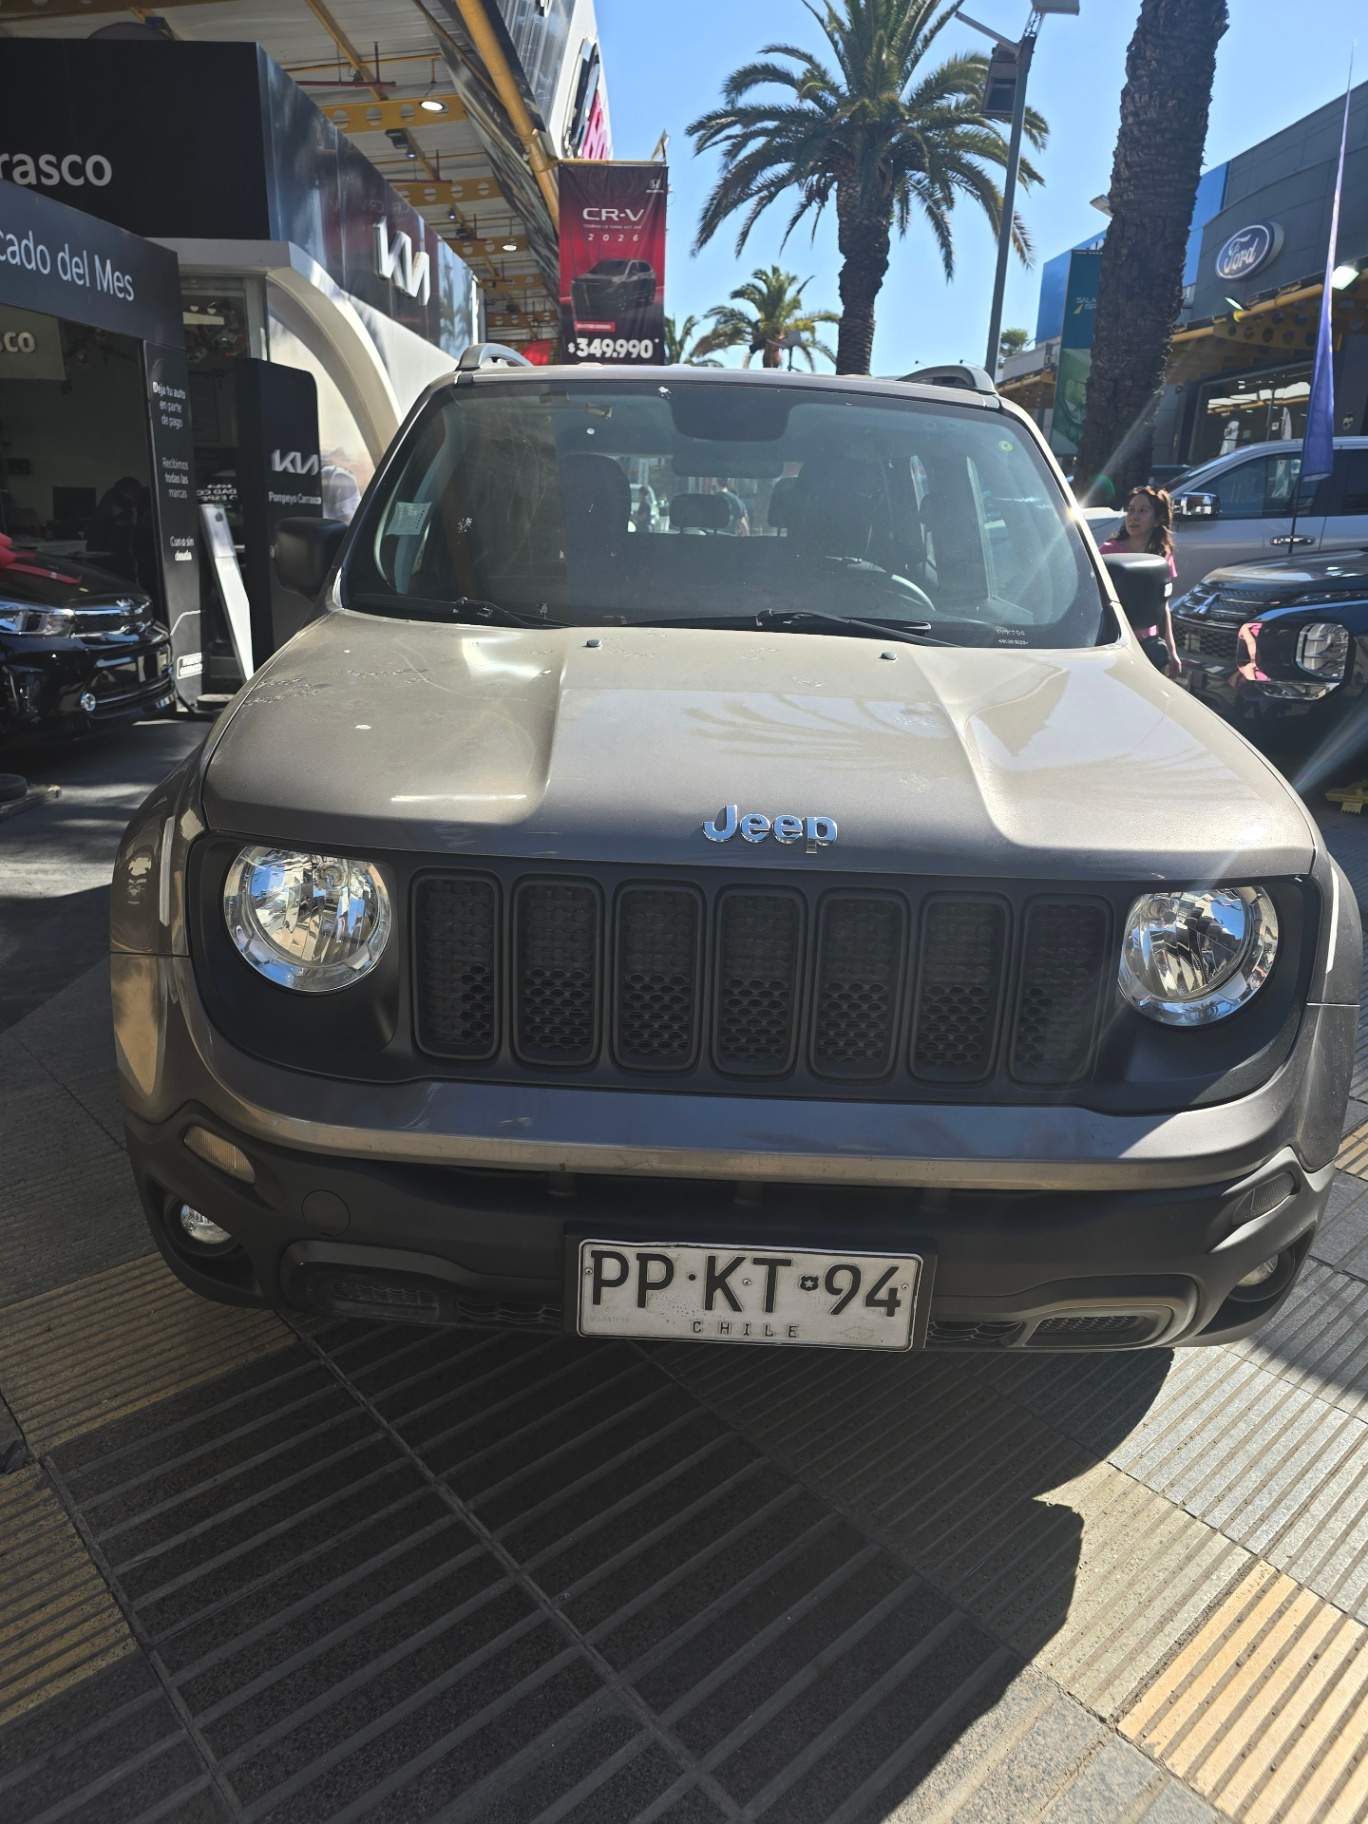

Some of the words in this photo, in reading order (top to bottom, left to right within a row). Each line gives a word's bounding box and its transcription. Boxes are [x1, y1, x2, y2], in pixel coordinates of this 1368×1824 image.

[583, 207, 645, 221] CR-V
[587, 233, 640, 242] 2026
[1223, 234, 1260, 274] Ford
[57, 243, 90, 287] del
[94, 254, 135, 301] Mes
[271, 449, 319, 475] KIA
[702, 804, 838, 853] Jeep
[691, 1320, 799, 1340] CHILE
